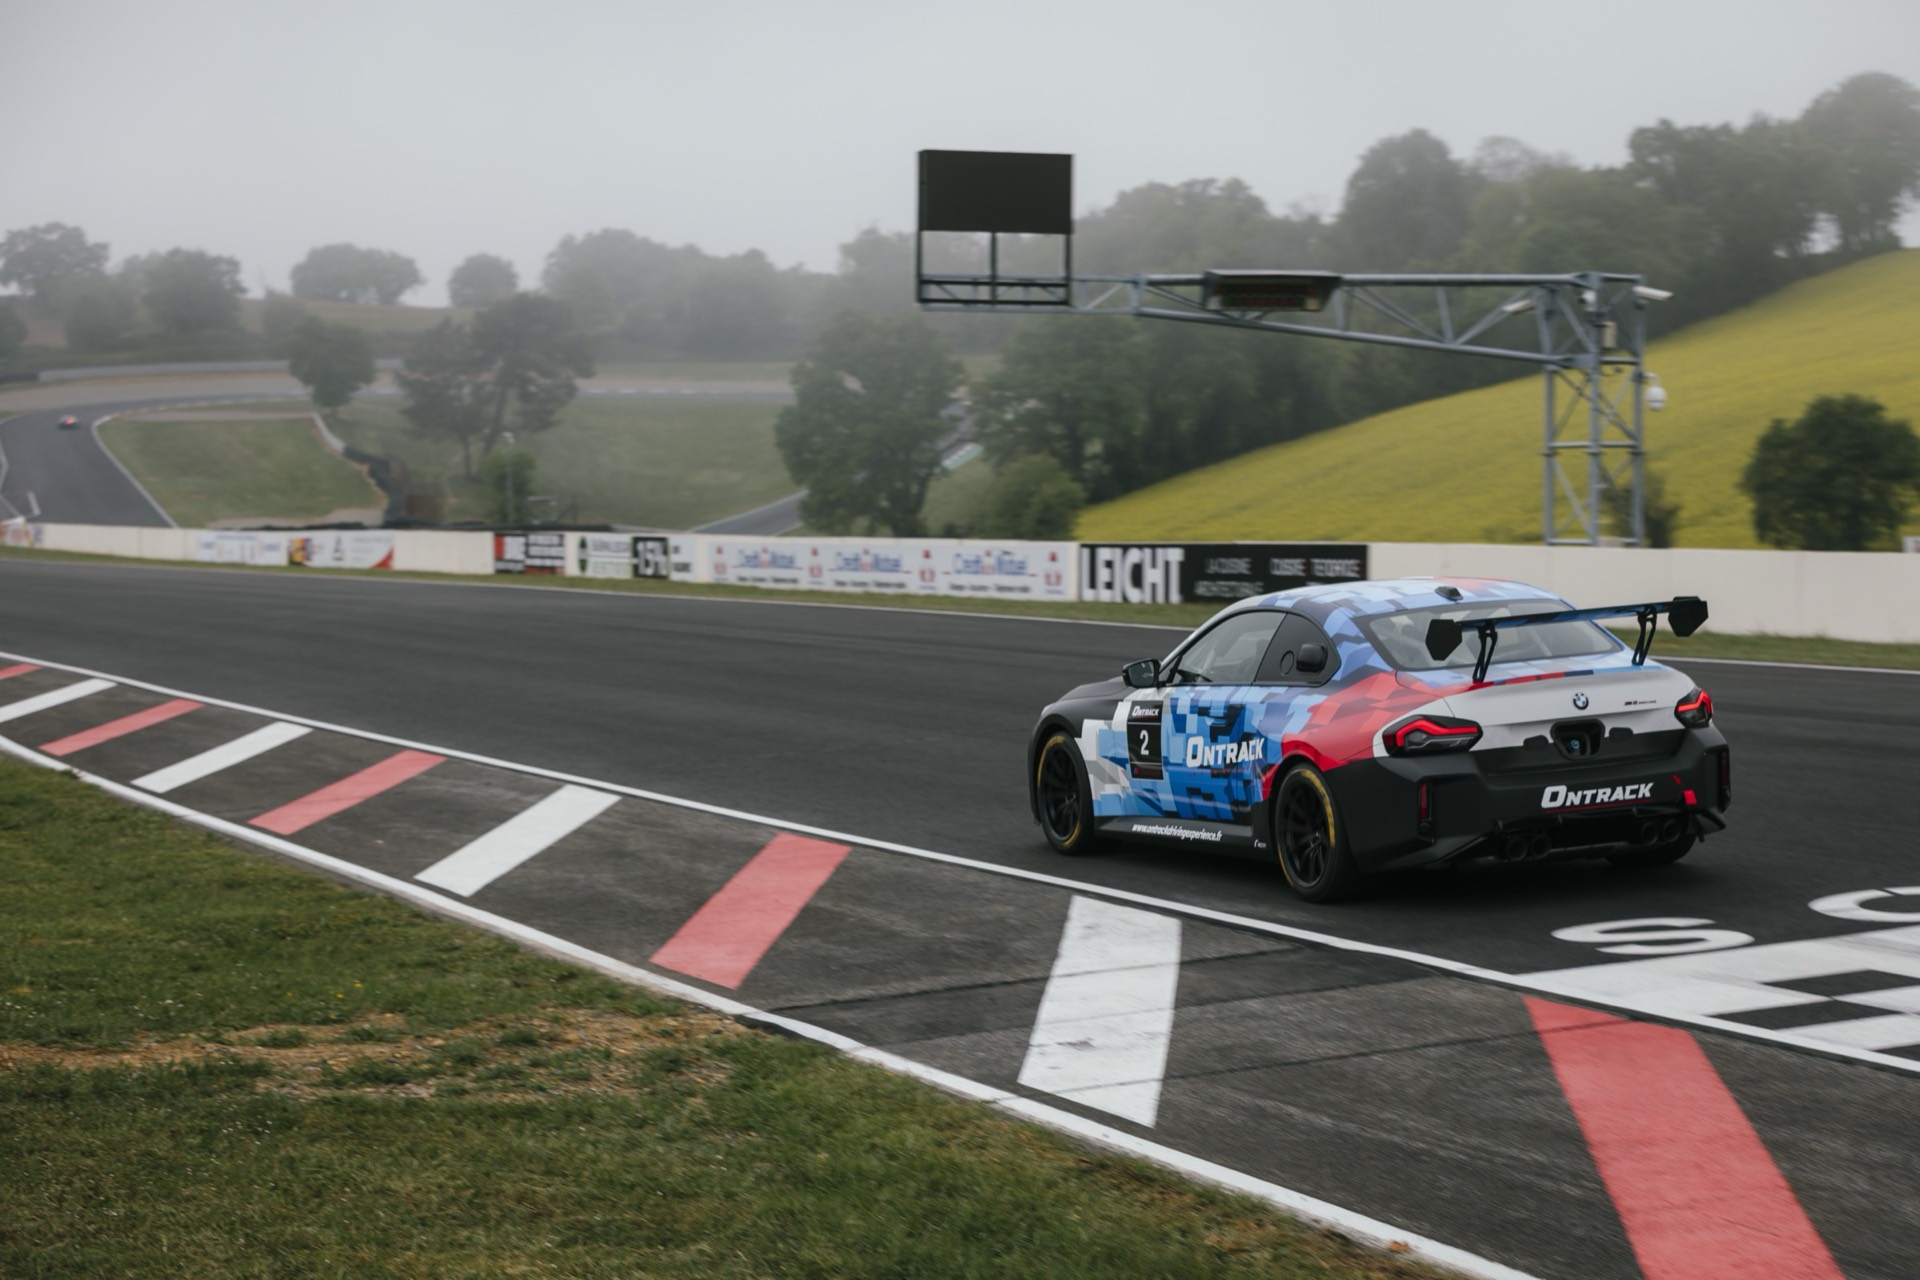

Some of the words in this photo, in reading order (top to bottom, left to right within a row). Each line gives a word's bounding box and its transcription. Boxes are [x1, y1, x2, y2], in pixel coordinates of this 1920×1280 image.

[1080, 546, 1184, 604] LEICHT
[1139, 729, 1150, 755] 2
[1186, 735, 1265, 768] ONTRACK
[1541, 782, 1654, 809] ONTRACK
